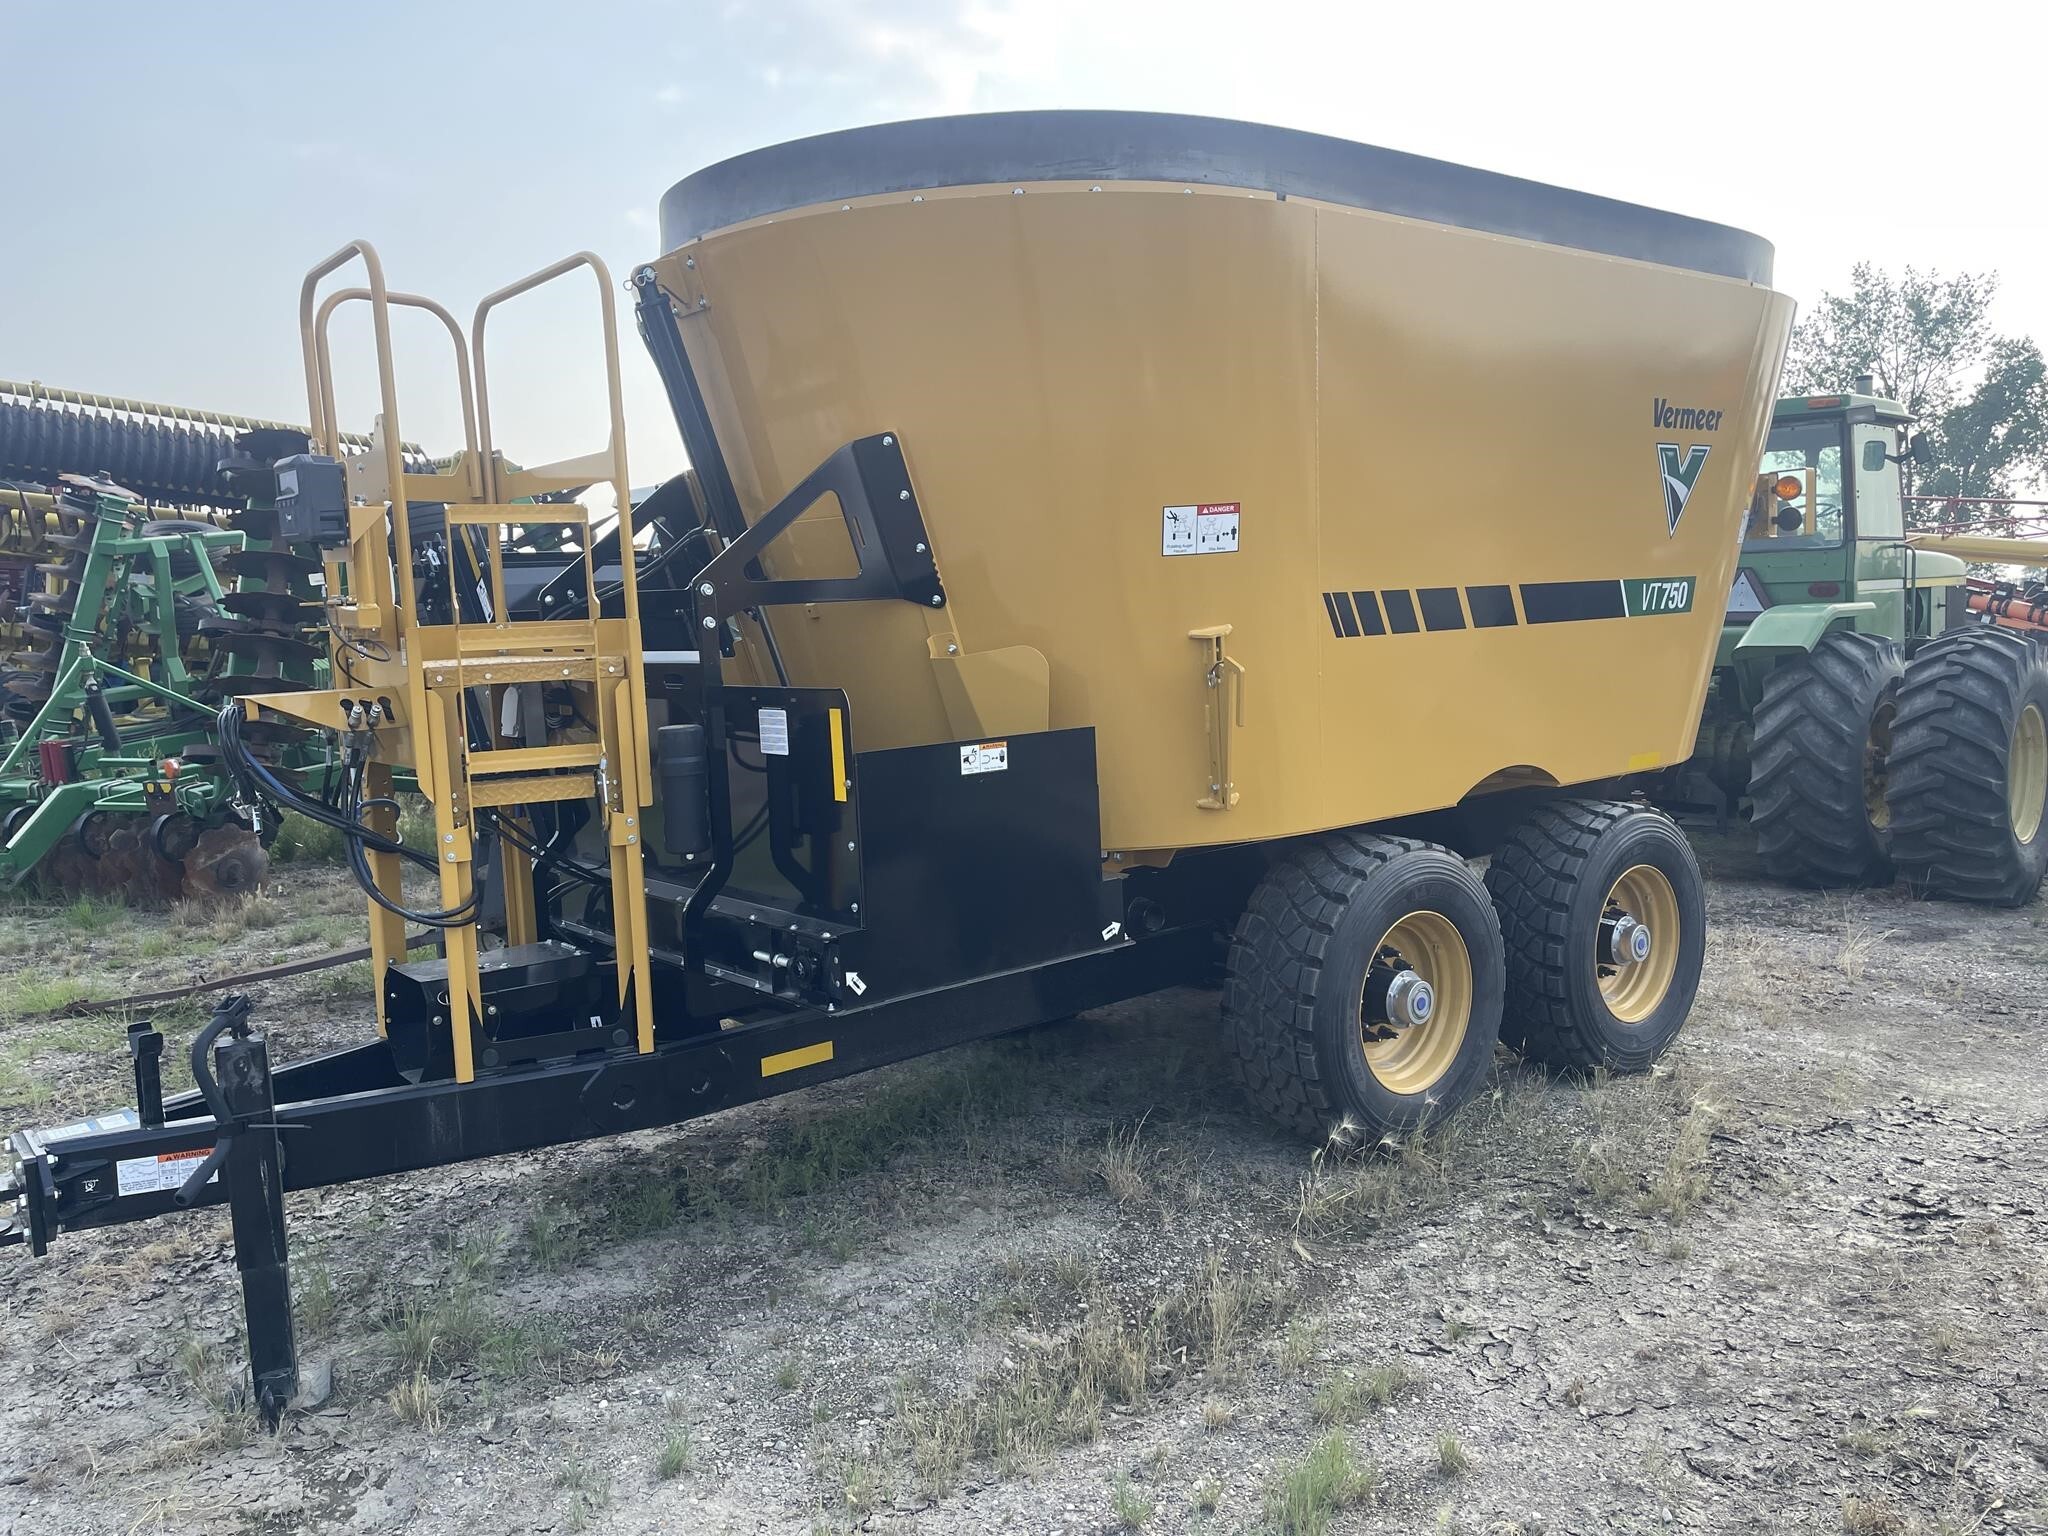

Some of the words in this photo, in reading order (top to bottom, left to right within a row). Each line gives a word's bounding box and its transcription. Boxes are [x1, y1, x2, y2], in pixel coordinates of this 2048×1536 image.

[1654, 397, 1723, 431] Vermeer
[1209, 505, 1235, 513] DANGER
[173, 1149, 210, 1160] WARNING
